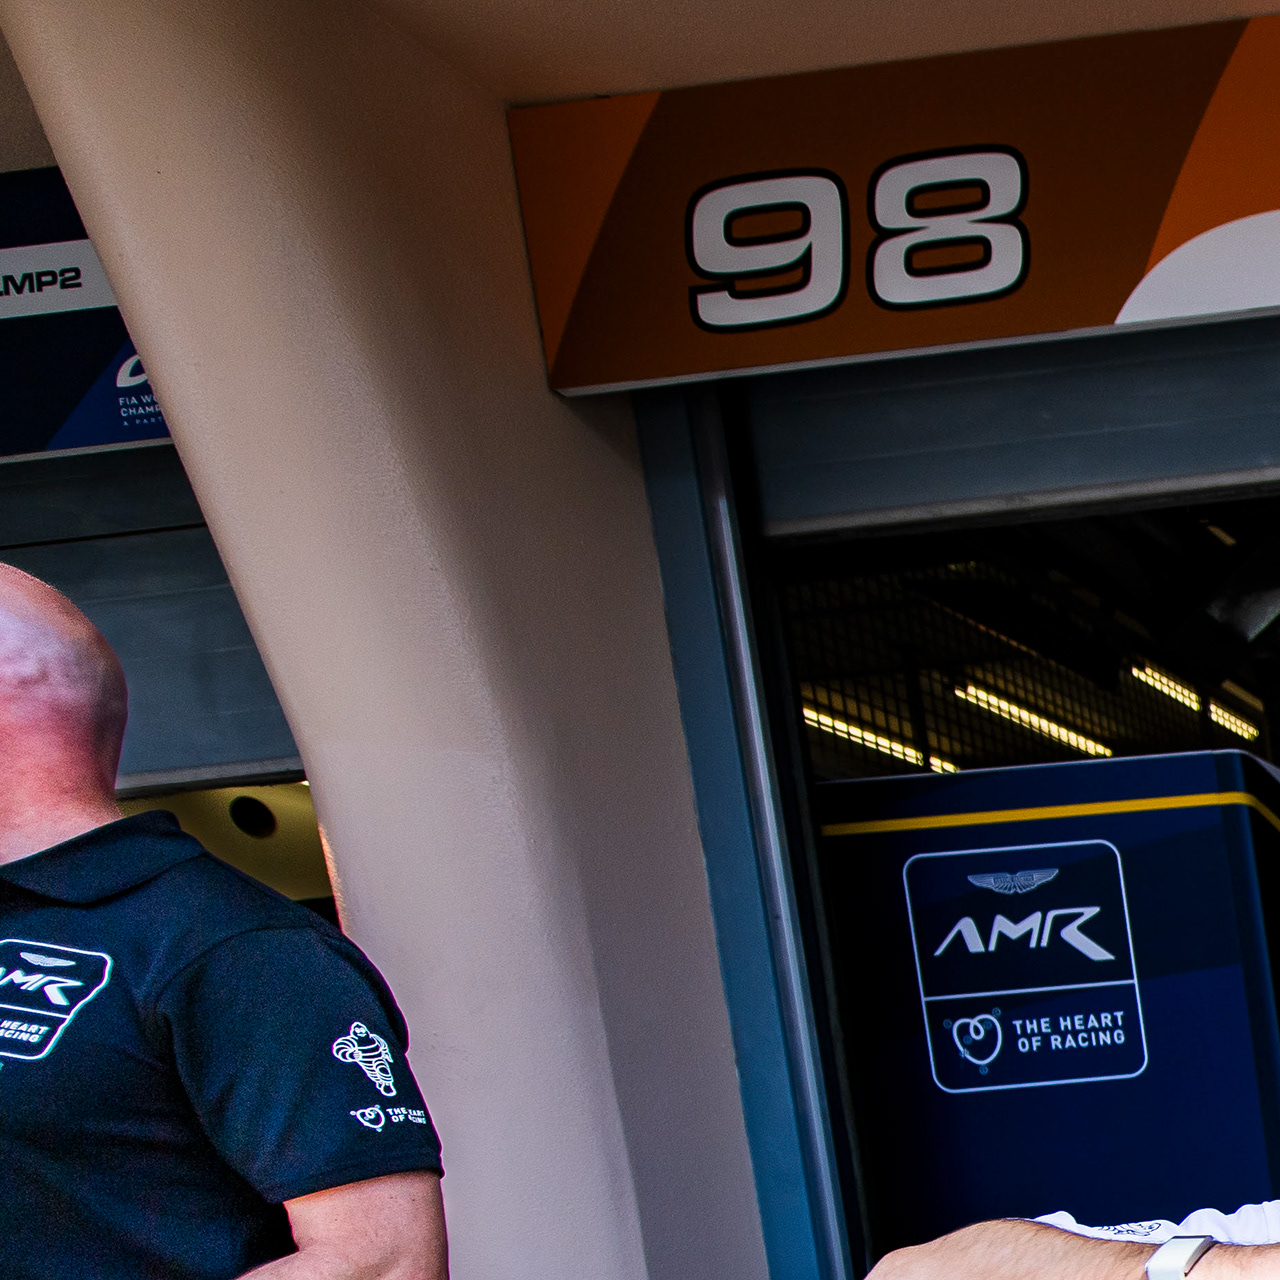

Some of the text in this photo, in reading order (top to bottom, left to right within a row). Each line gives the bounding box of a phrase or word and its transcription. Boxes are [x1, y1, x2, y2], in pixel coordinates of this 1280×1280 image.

[688, 147, 1028, 330] 98
[0, 266, 83, 297] MP2
[933, 905, 1116, 961] AMR
[0, 967, 85, 1006] MR
[0, 1019, 50, 1035] HEART
[0, 1028, 43, 1043] ACING
[1012, 1011, 1126, 1035] THE HEART
[1017, 1028, 1126, 1053] OF RACING
